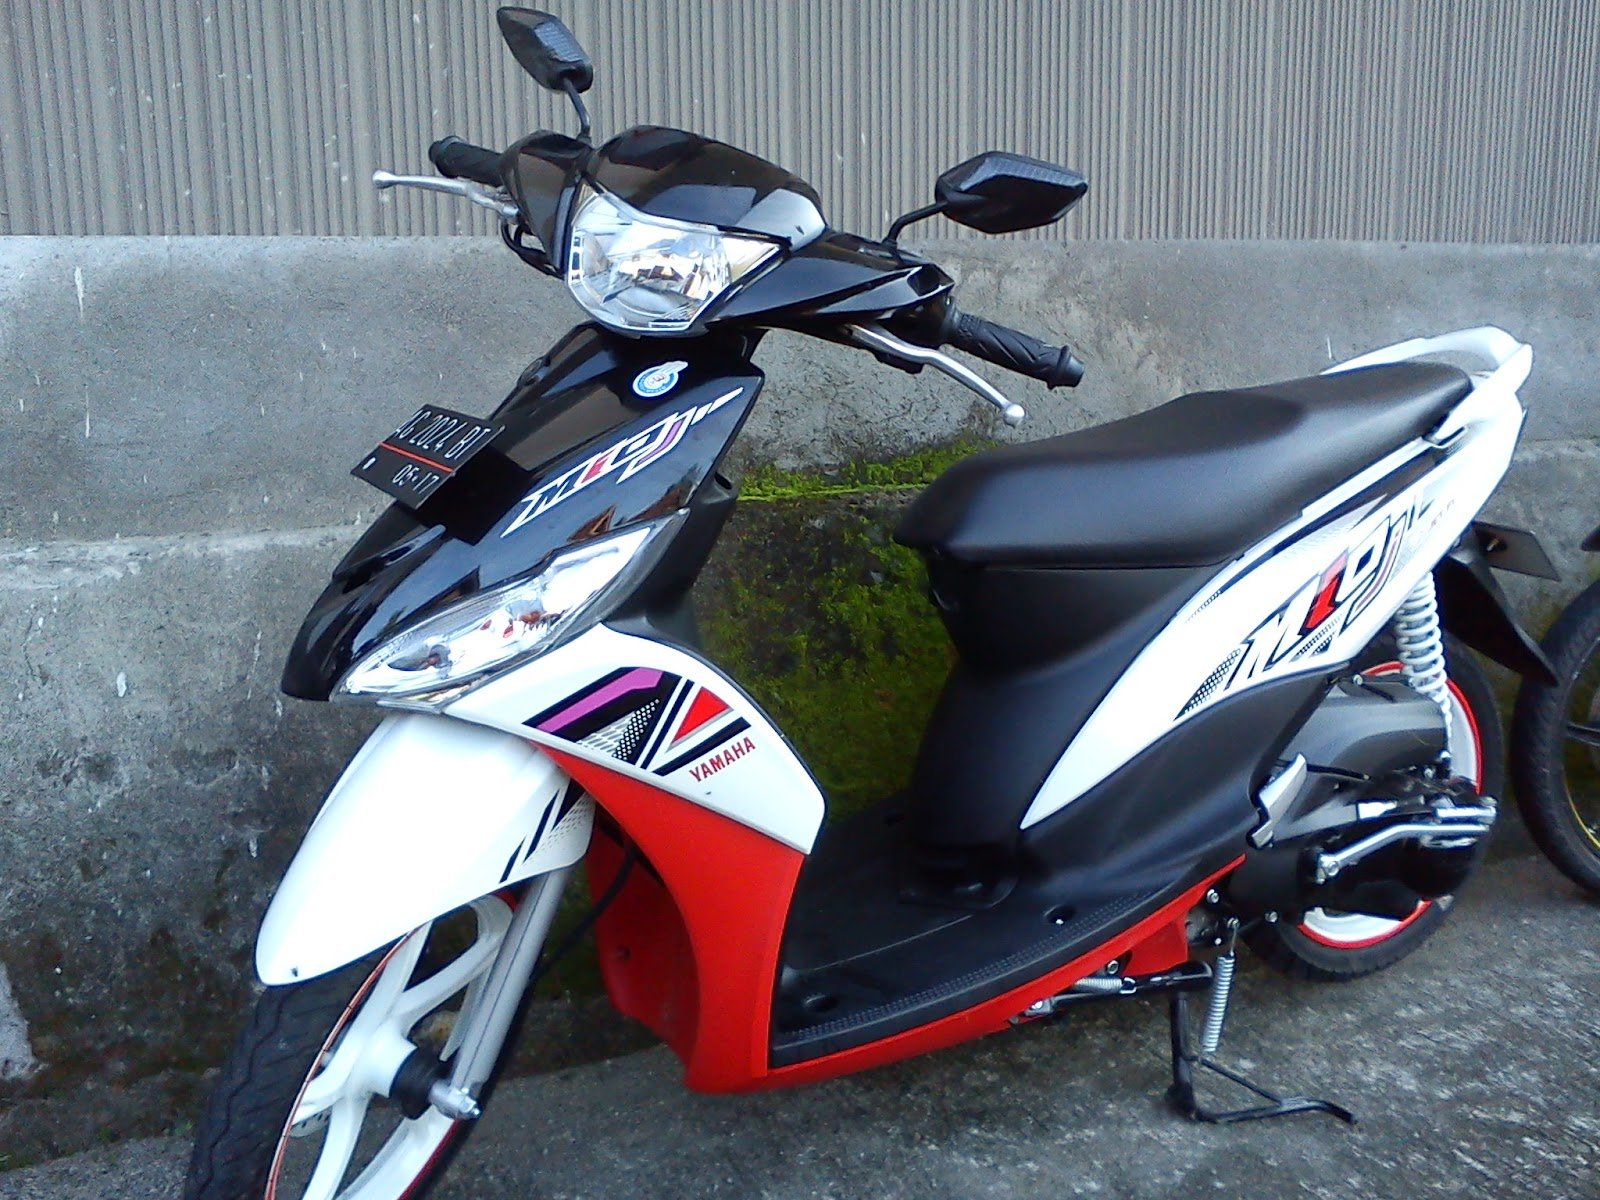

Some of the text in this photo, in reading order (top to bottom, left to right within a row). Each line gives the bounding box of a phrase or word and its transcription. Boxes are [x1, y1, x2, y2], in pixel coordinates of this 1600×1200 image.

[409, 415, 468, 452] 2024
[444, 426, 491, 460] BT
[688, 736, 756, 783] YAMAHA
